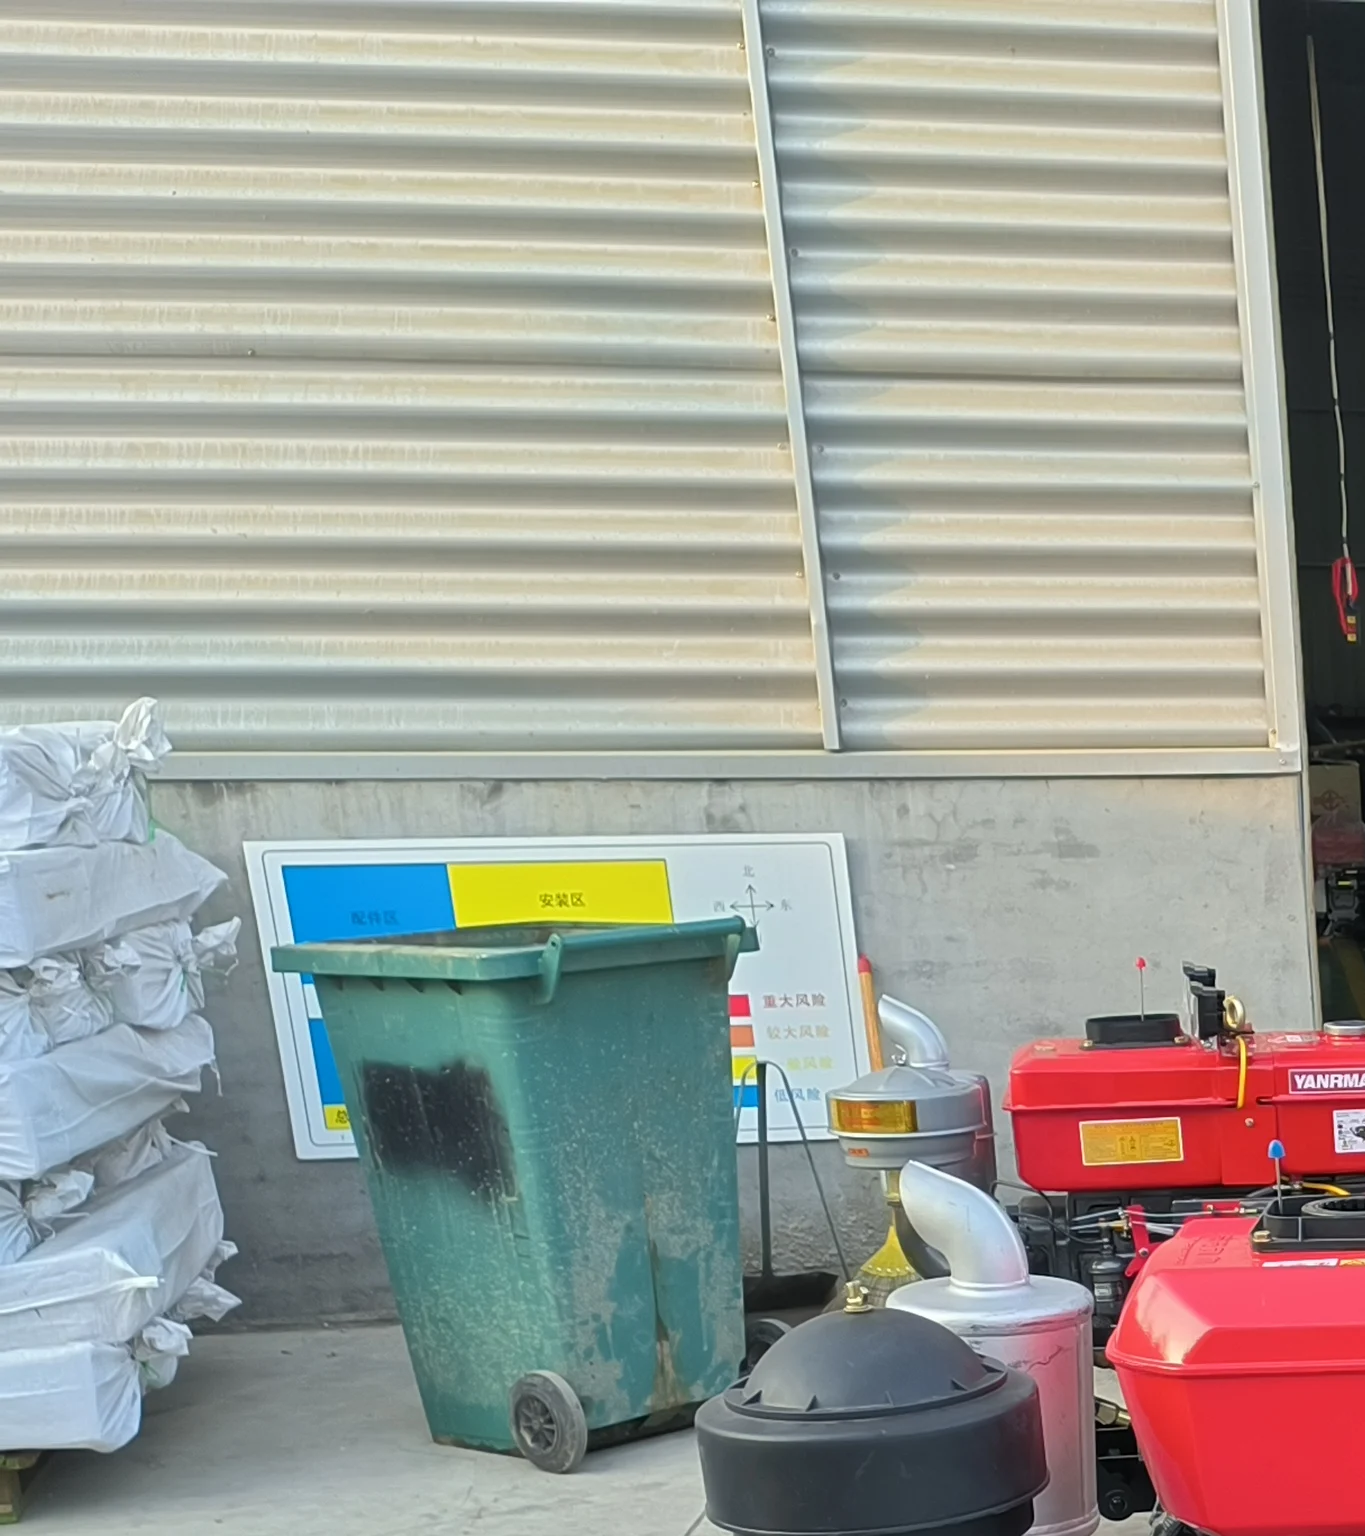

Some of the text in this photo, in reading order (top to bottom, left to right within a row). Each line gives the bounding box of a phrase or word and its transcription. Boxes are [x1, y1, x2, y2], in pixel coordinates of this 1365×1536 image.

[743, 864, 755, 878] 北
[538, 891, 587, 909] 安装区
[350, 909, 400, 926] 配件区
[762, 993, 827, 1009] 重大风险
[766, 1024, 832, 1041] 较大风险
[774, 1087, 821, 1103] 低风险
